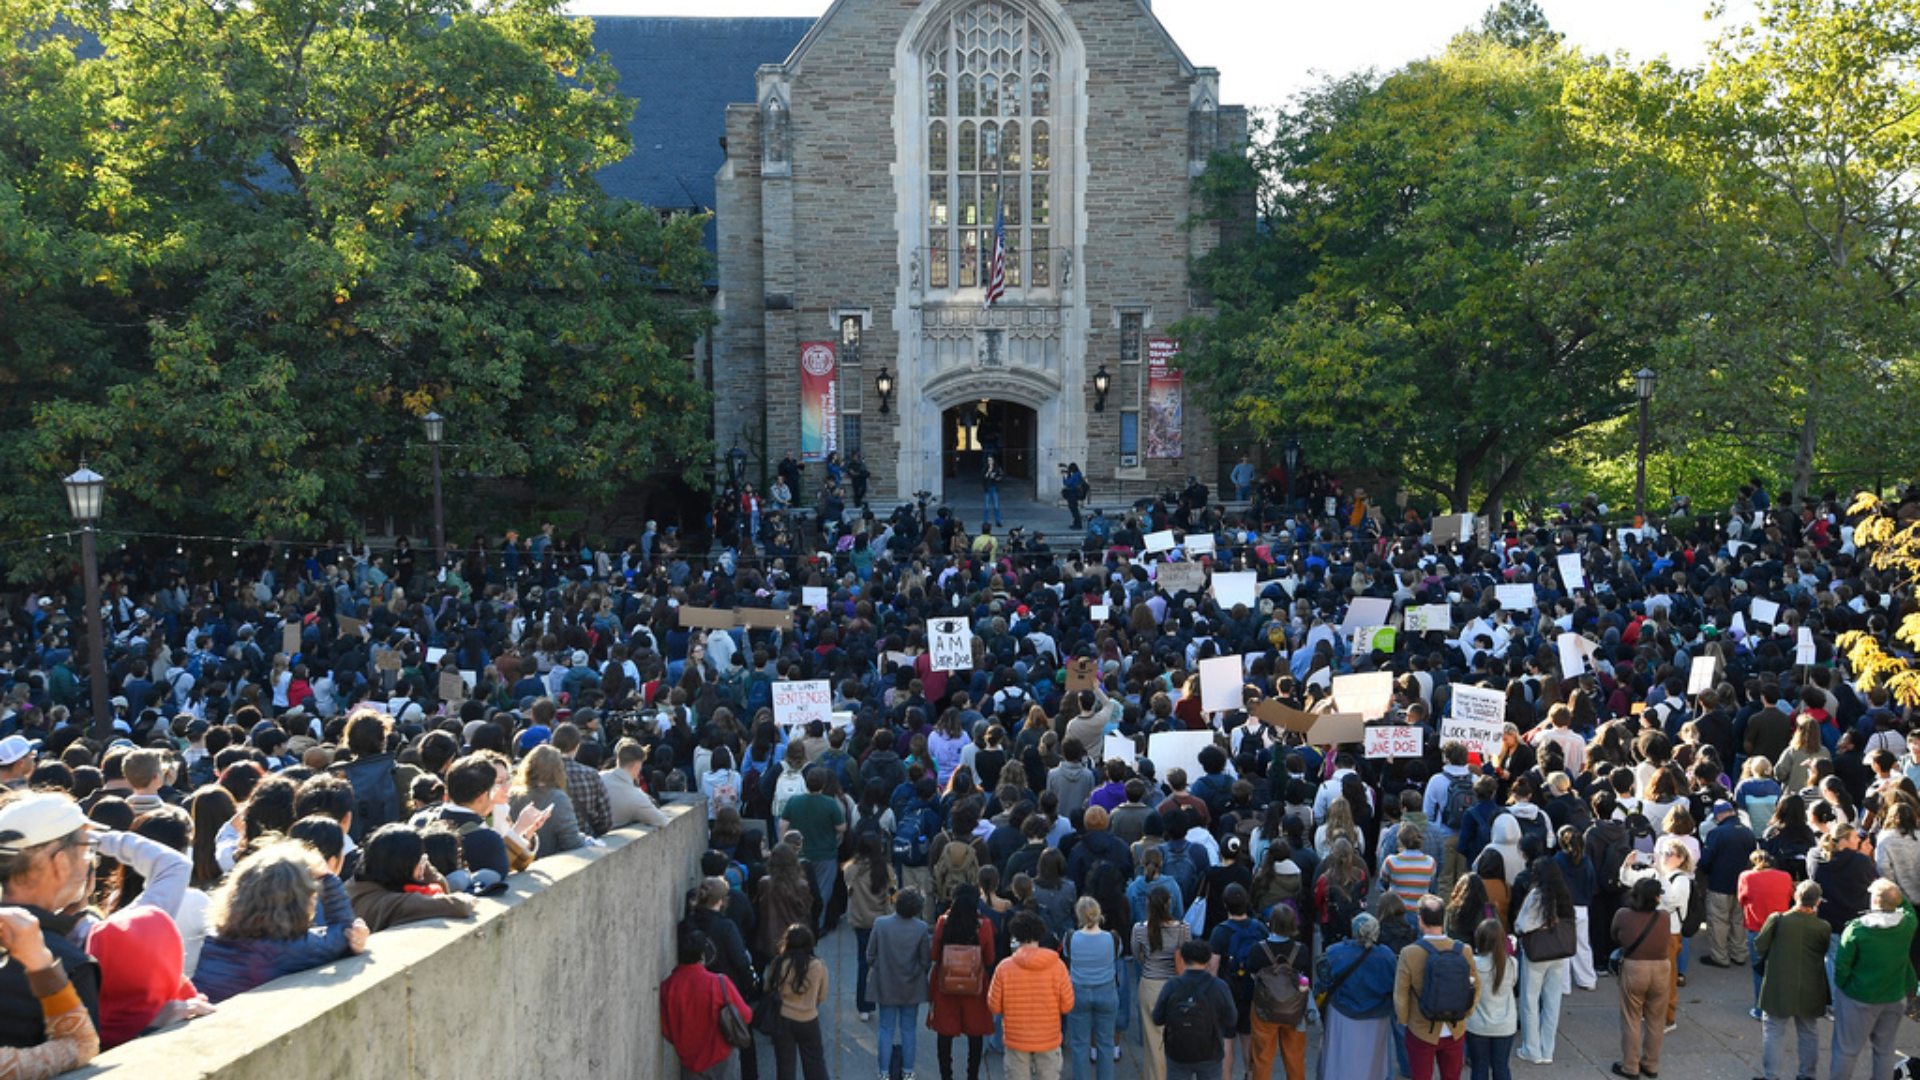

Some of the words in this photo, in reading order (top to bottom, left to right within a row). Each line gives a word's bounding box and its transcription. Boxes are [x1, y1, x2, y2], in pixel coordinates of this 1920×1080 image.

[827, 381, 836, 413] Union
[826, 416, 837, 451] tudent
[936, 635, 944, 651] A
[948, 636, 963, 651] M
[932, 653, 953, 669] Jane
[954, 652, 971, 667] Doe
[797, 682, 819, 690] WANT
[776, 690, 829, 706] SENTENCES
[1374, 728, 1389, 739] WE
[1391, 726, 1412, 738] ARE
[1443, 725, 1466, 738] LOCK
[1469, 727, 1491, 741] THEM
[1493, 732, 1503, 742] UP
[1367, 740, 1390, 755] JANE
[1393, 740, 1416, 753] DOE
[1460, 740, 1484, 751] NOW
